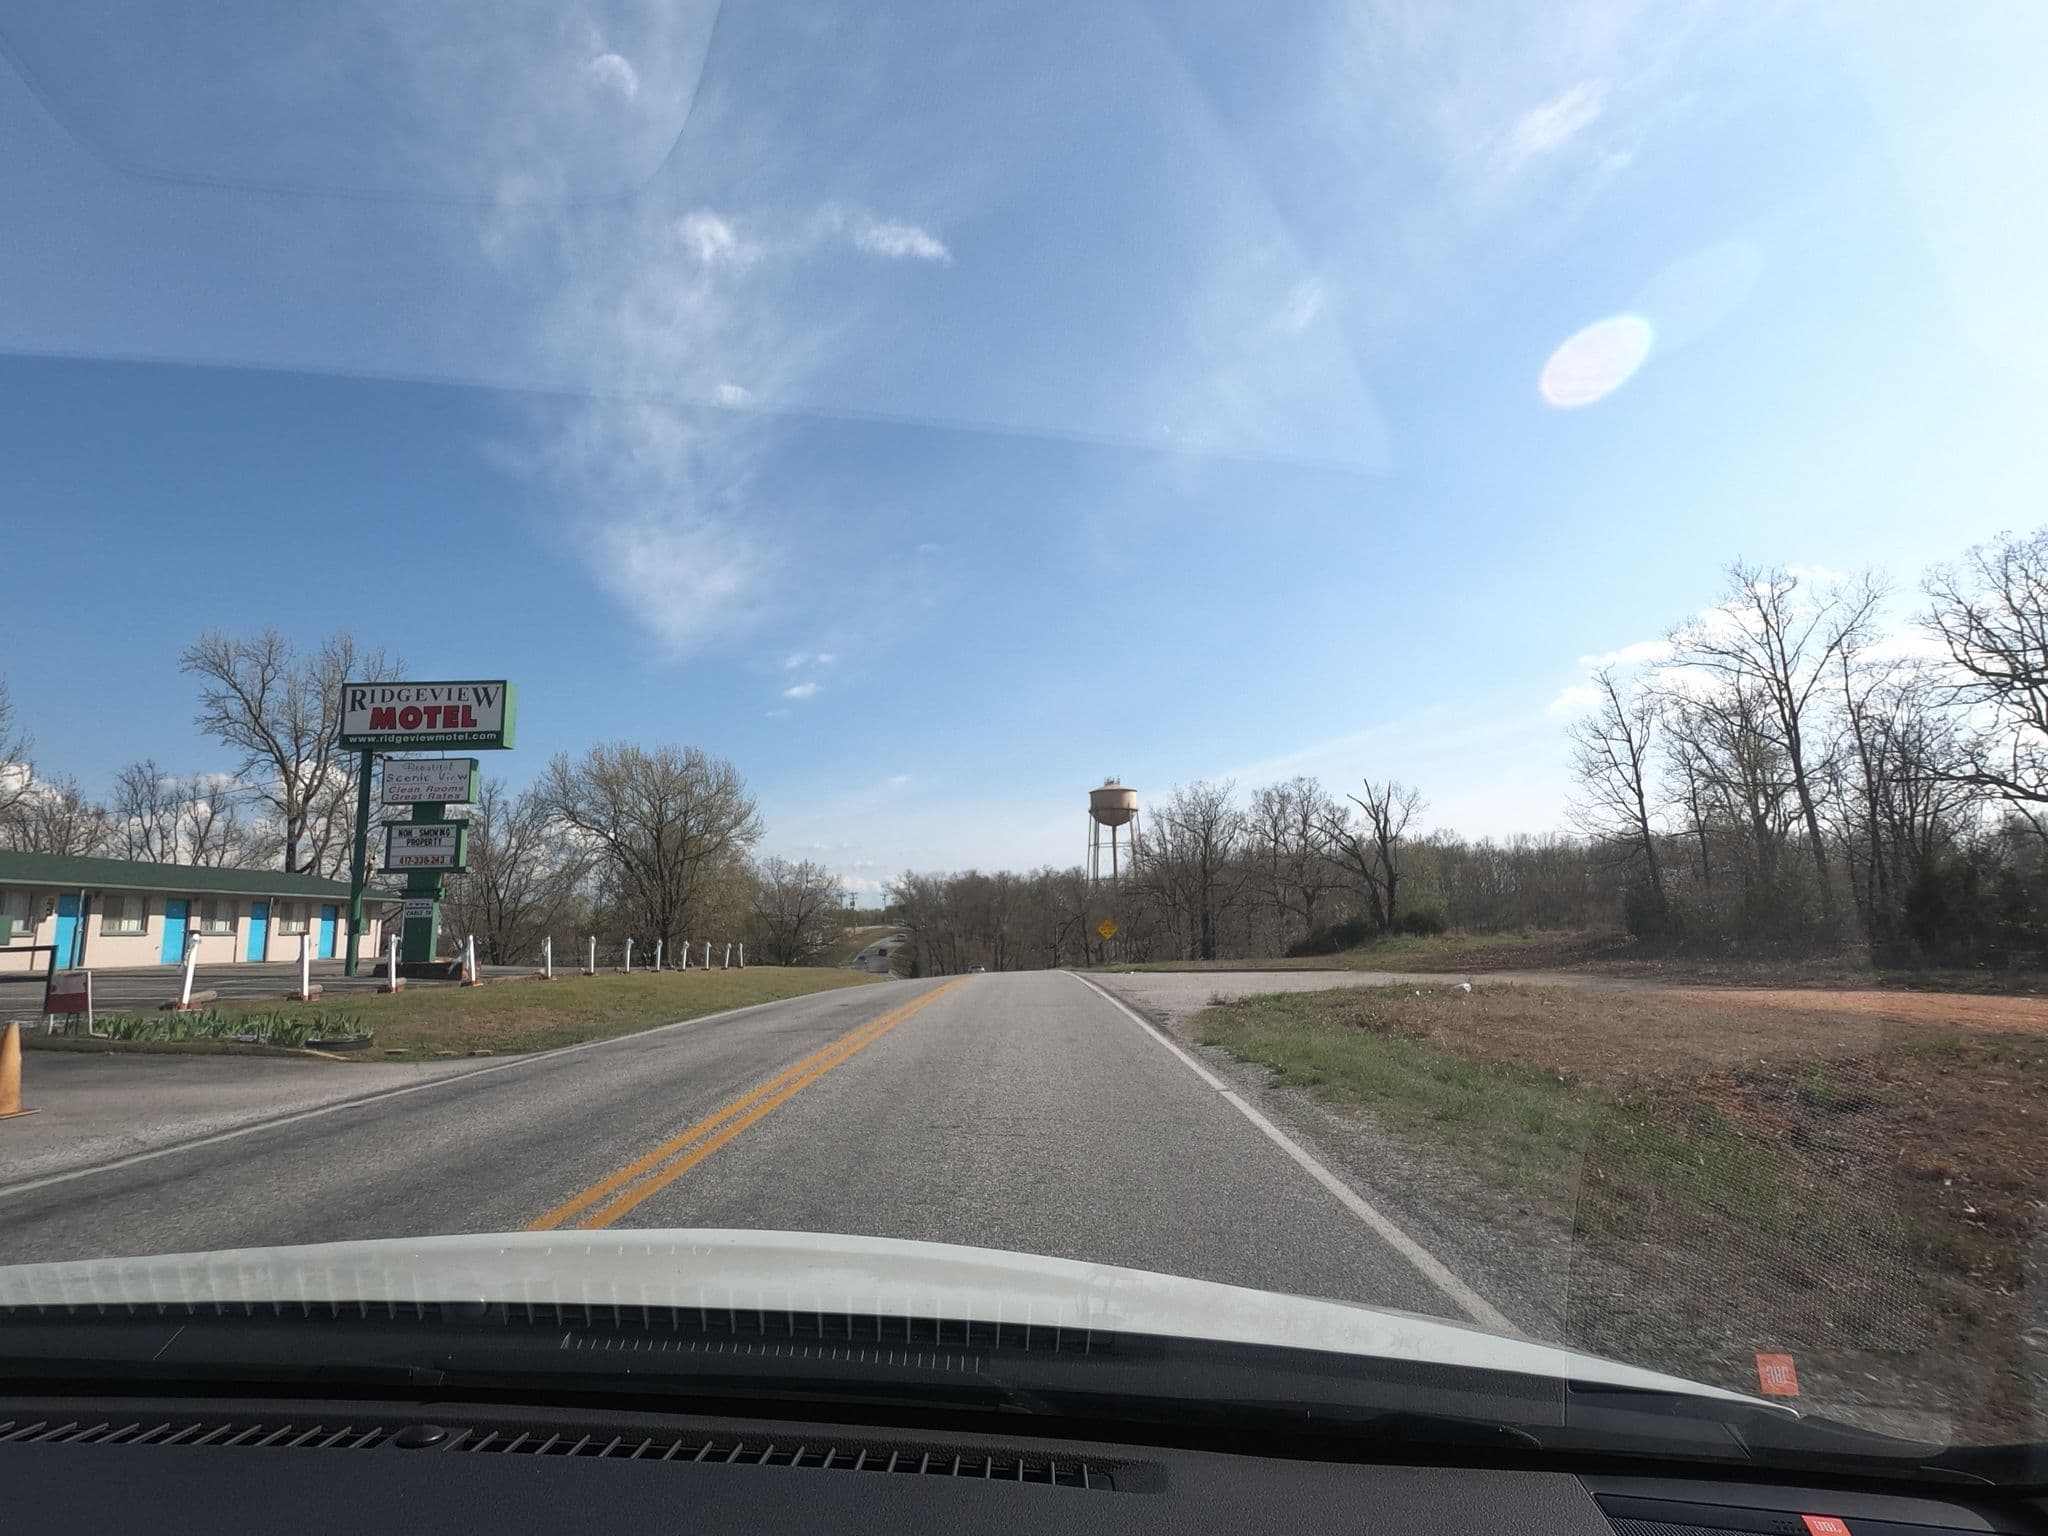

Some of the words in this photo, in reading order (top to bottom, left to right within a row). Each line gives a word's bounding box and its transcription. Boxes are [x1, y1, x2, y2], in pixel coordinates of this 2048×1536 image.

[348, 686, 500, 711] RIDGEVIEW
[369, 705, 477, 730] MOTEL
[349, 732, 497, 744] www.ridgeviewmotel.com
[386, 773, 430, 782] Scenic
[389, 786, 421, 794] Clean
[426, 785, 465, 793] Rooms
[399, 829, 413, 837] NON
[419, 828, 450, 837] SMOKING
[407, 838, 442, 847] PROPERTY
